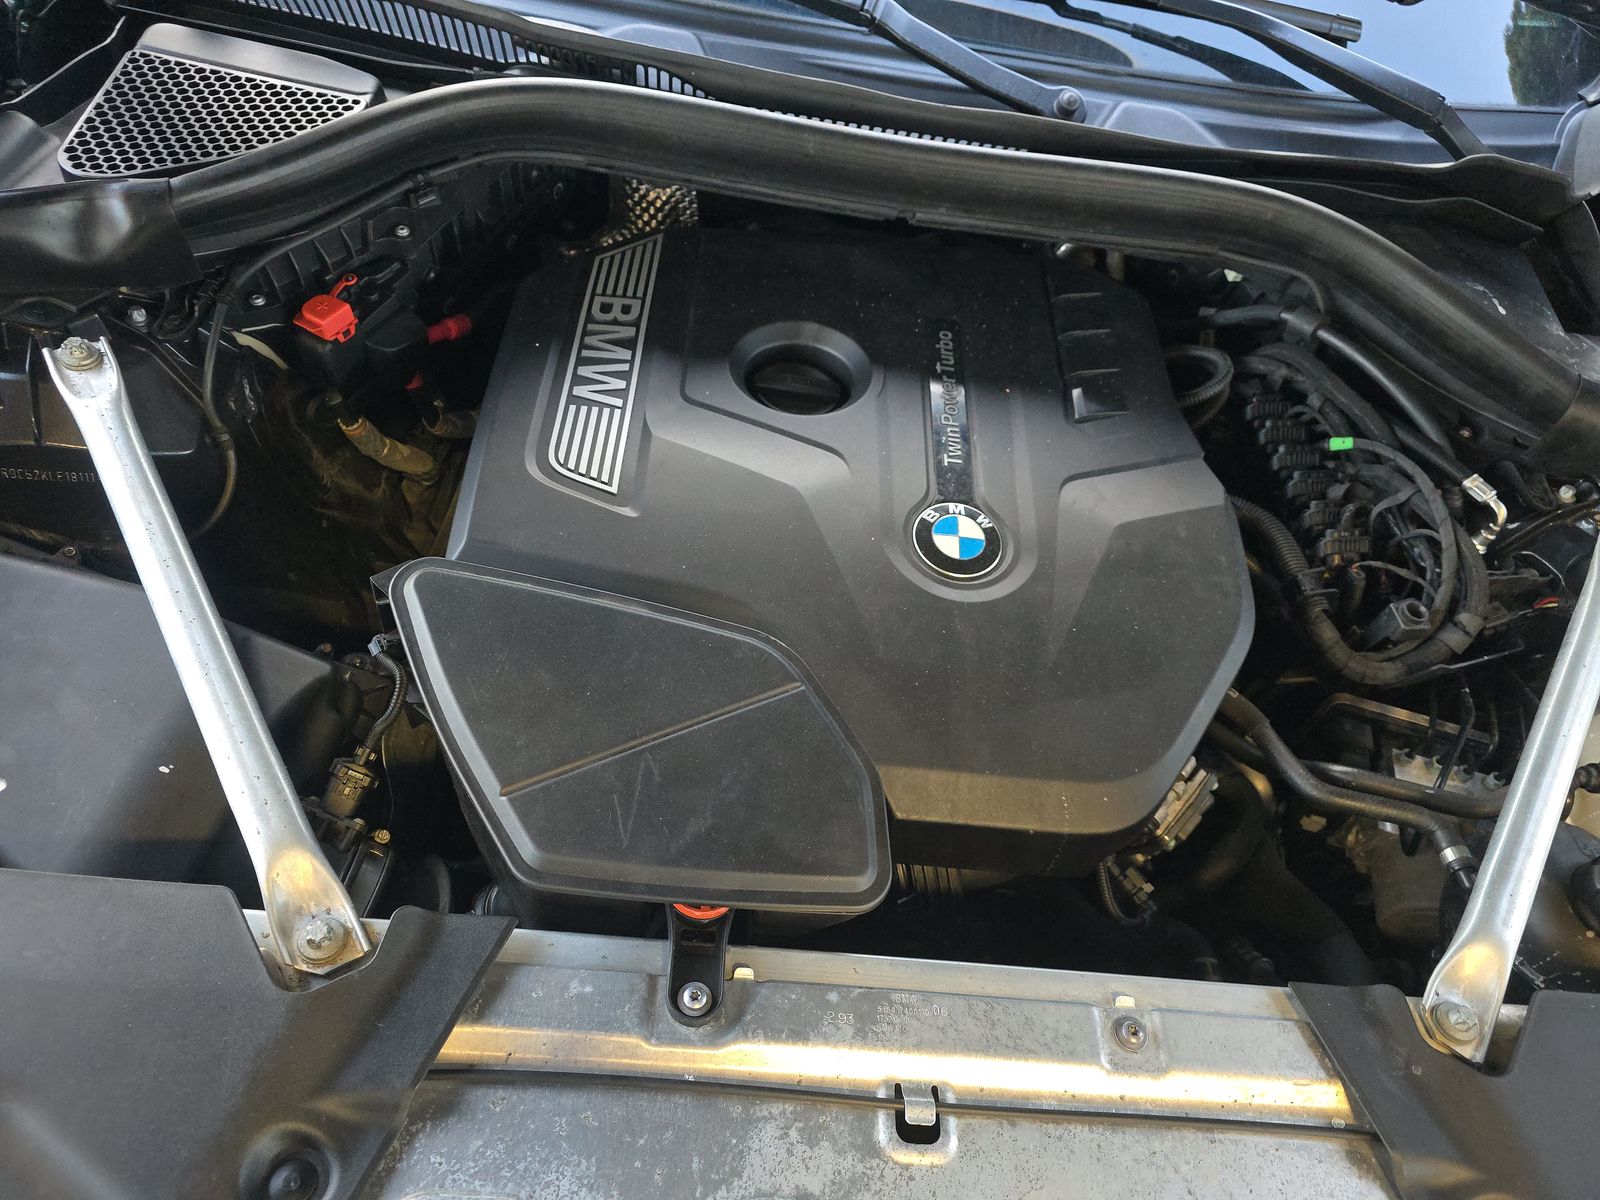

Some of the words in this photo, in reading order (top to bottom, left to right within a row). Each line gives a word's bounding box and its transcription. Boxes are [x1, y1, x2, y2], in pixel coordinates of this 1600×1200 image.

[572, 295, 642, 408] BMW
[936, 330, 954, 373] Turbo
[940, 374, 963, 466] TwinPower
[922, 503, 993, 530] BMW
